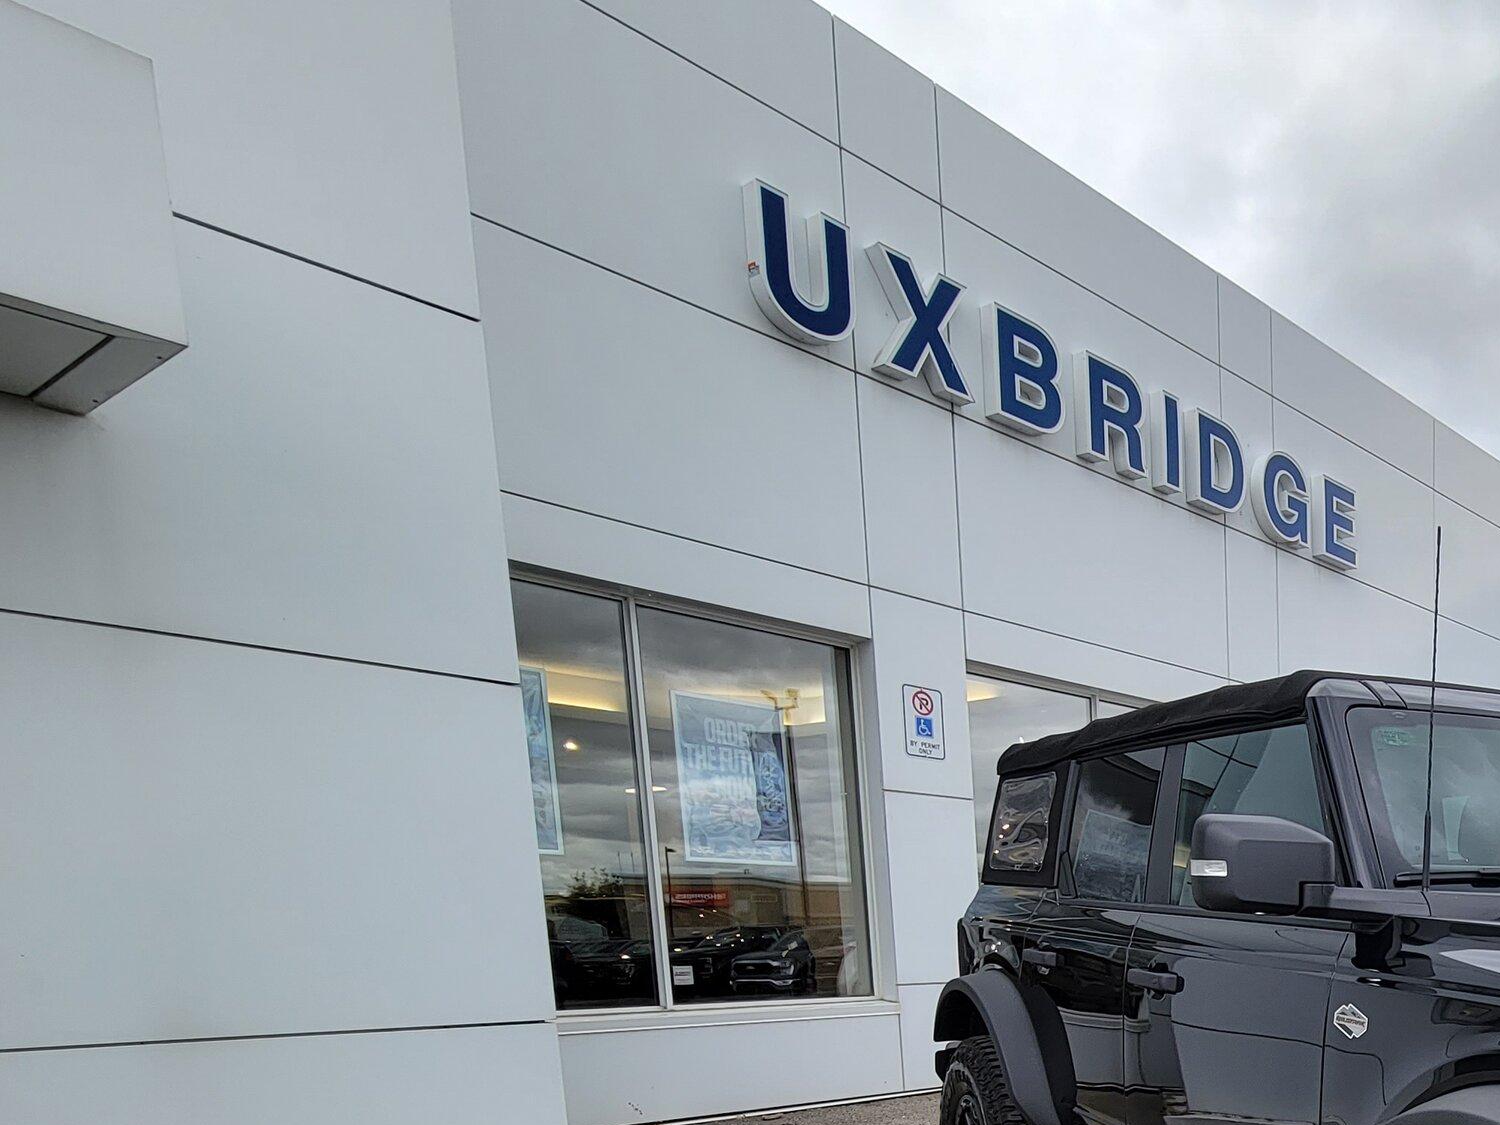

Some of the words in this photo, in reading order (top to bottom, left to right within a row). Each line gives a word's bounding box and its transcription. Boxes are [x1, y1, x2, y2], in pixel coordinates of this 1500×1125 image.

[743, 178, 1358, 571] UXBRIDGE
[921, 741, 940, 750] PERMIT
[919, 747, 932, 755] ONLY
